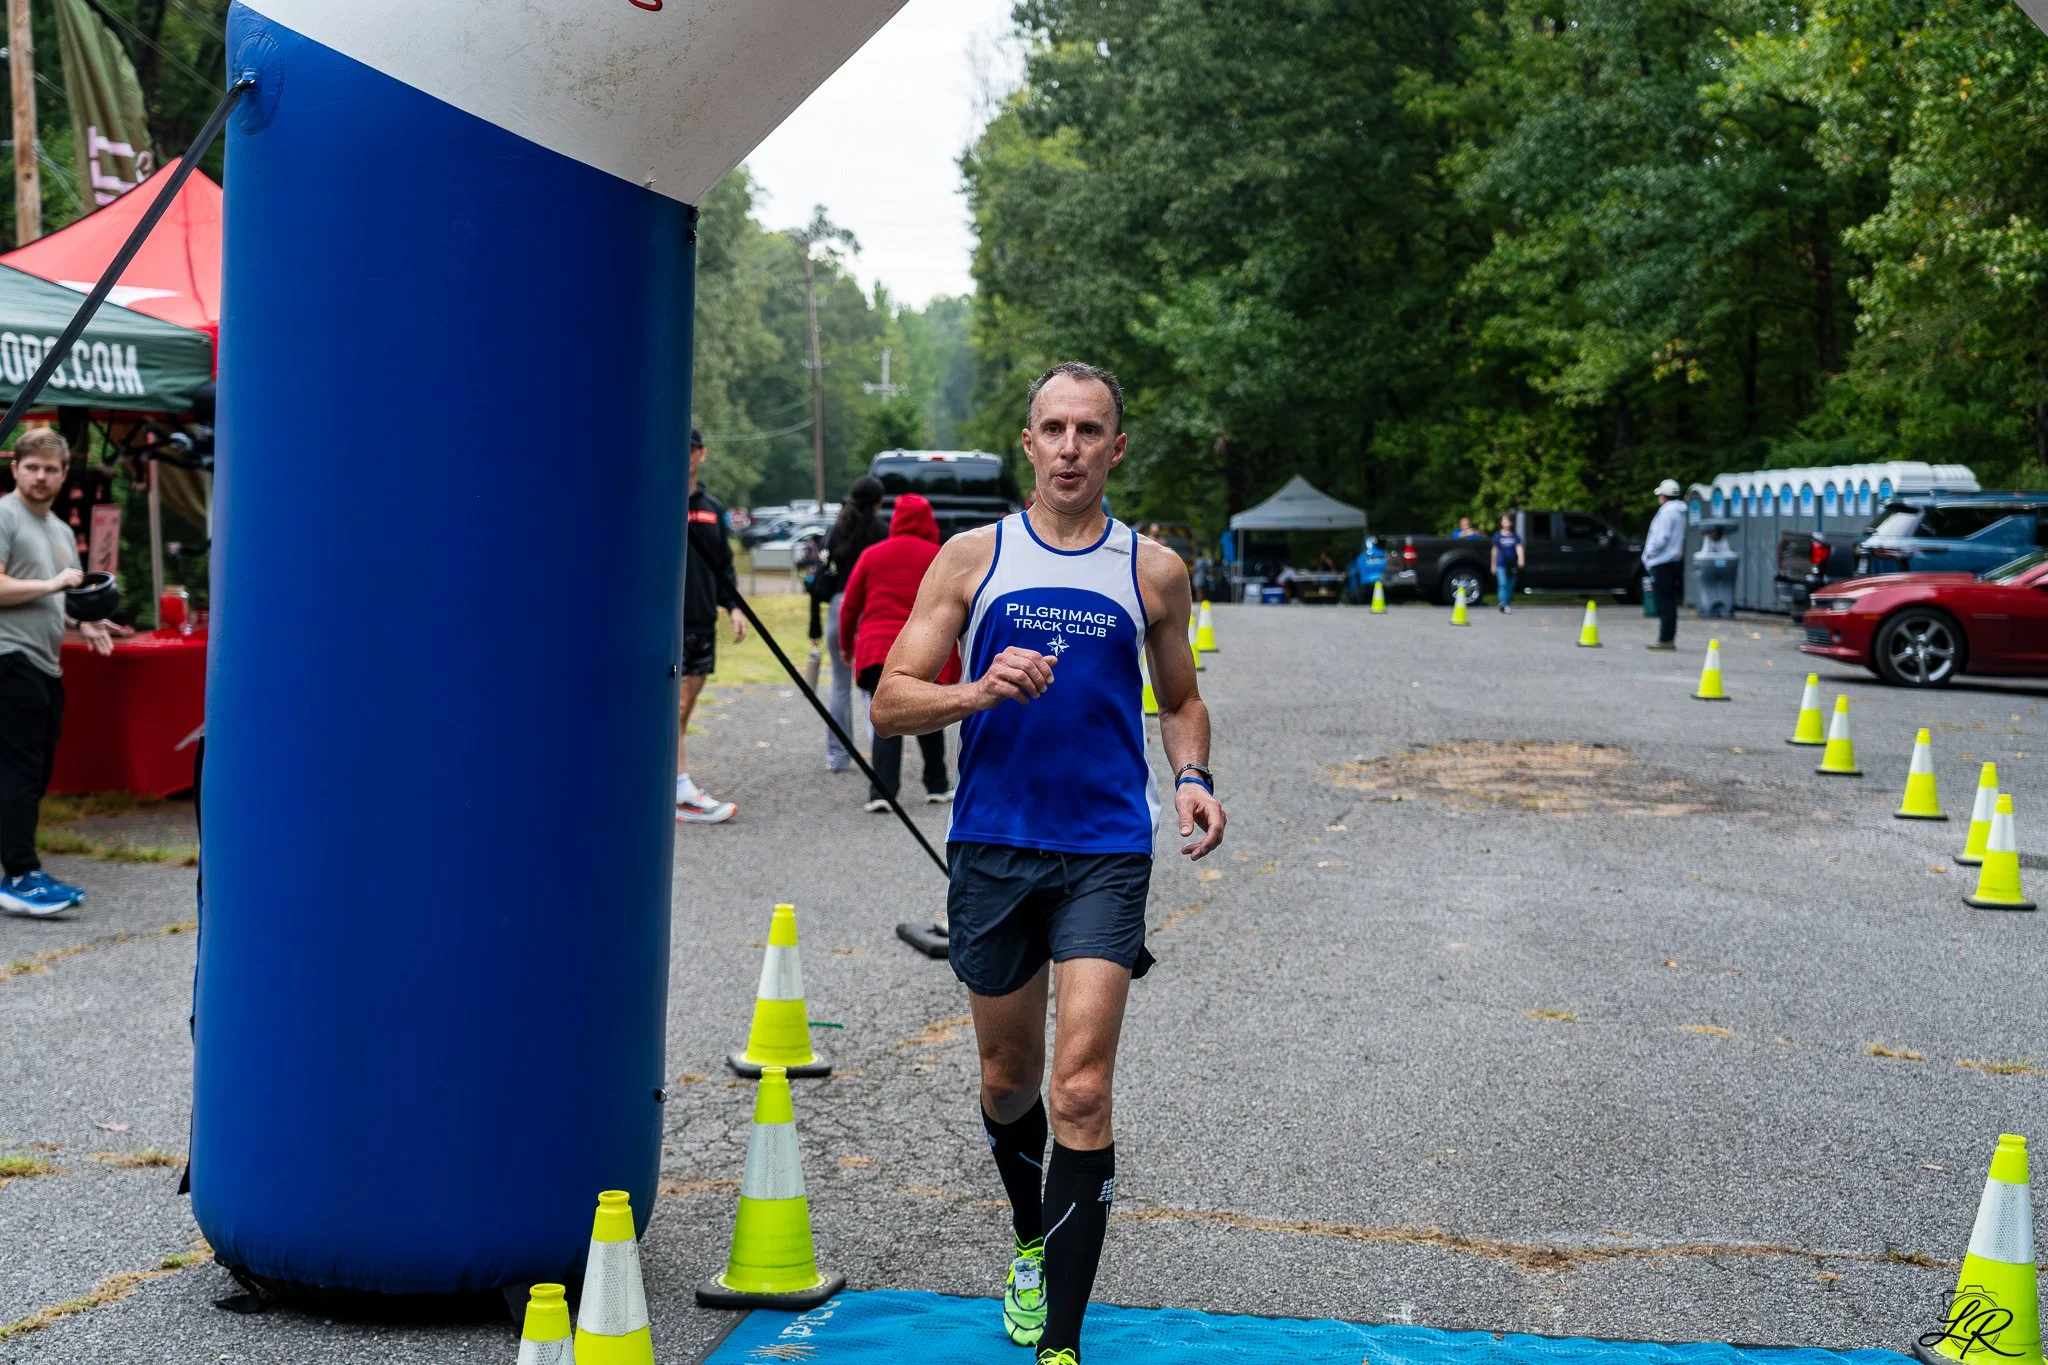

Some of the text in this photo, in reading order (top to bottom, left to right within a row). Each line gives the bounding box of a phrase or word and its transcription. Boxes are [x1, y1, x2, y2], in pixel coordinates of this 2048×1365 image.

[1006, 603, 1117, 627] PILGRIMAGE
[1014, 618, 1107, 638] TRACK CLUB
